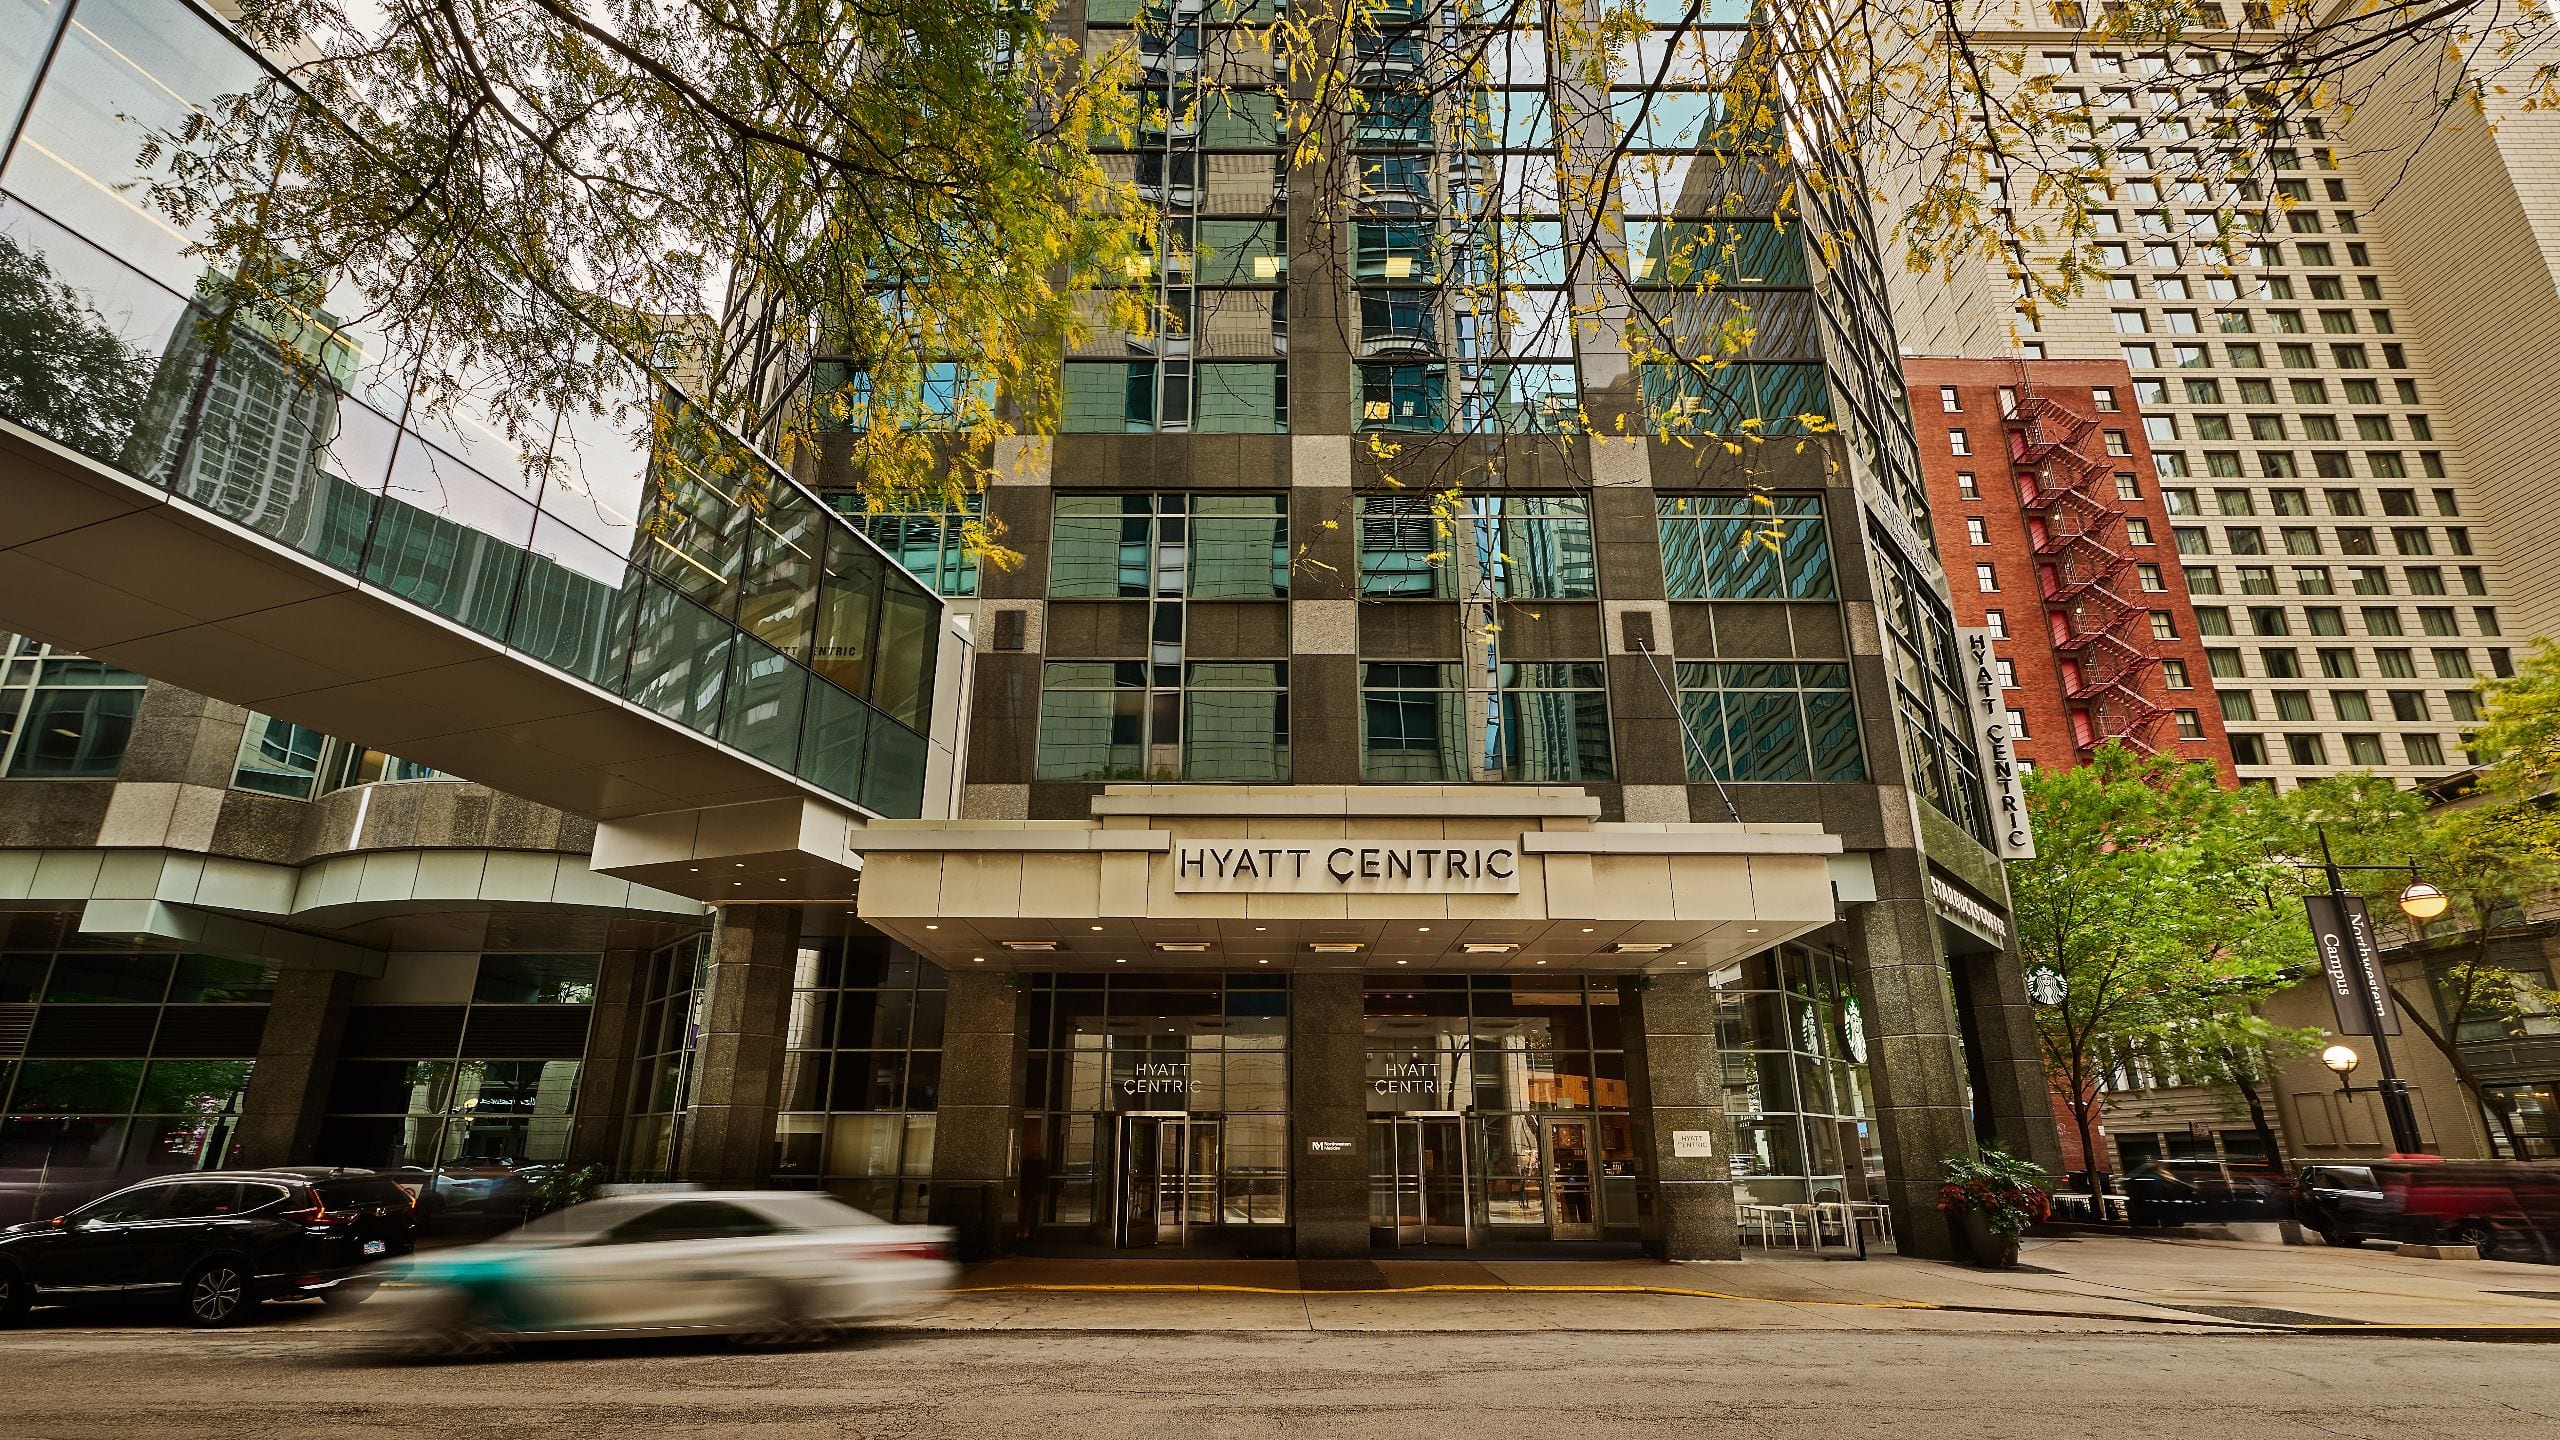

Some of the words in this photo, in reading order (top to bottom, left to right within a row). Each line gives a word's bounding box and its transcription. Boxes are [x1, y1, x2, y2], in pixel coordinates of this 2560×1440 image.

[814, 646, 856, 656] ENTRIC
[1969, 634, 1996, 714] HYATT
[1987, 724, 2026, 848] CENTRIC
[1180, 848, 1311, 879] HYATT
[1327, 847, 1514, 884] CENTRIC
[1930, 875, 1981, 922] STARBUCKS
[1979, 906, 2007, 937] COFFEE
[2323, 933, 2350, 996] Campus
[1136, 1063, 1191, 1077] HYATT
[1385, 1063, 1440, 1077] HYATT
[1123, 1079, 1202, 1096] CENTRIC
[1374, 1079, 1453, 1096] CENTRIC
